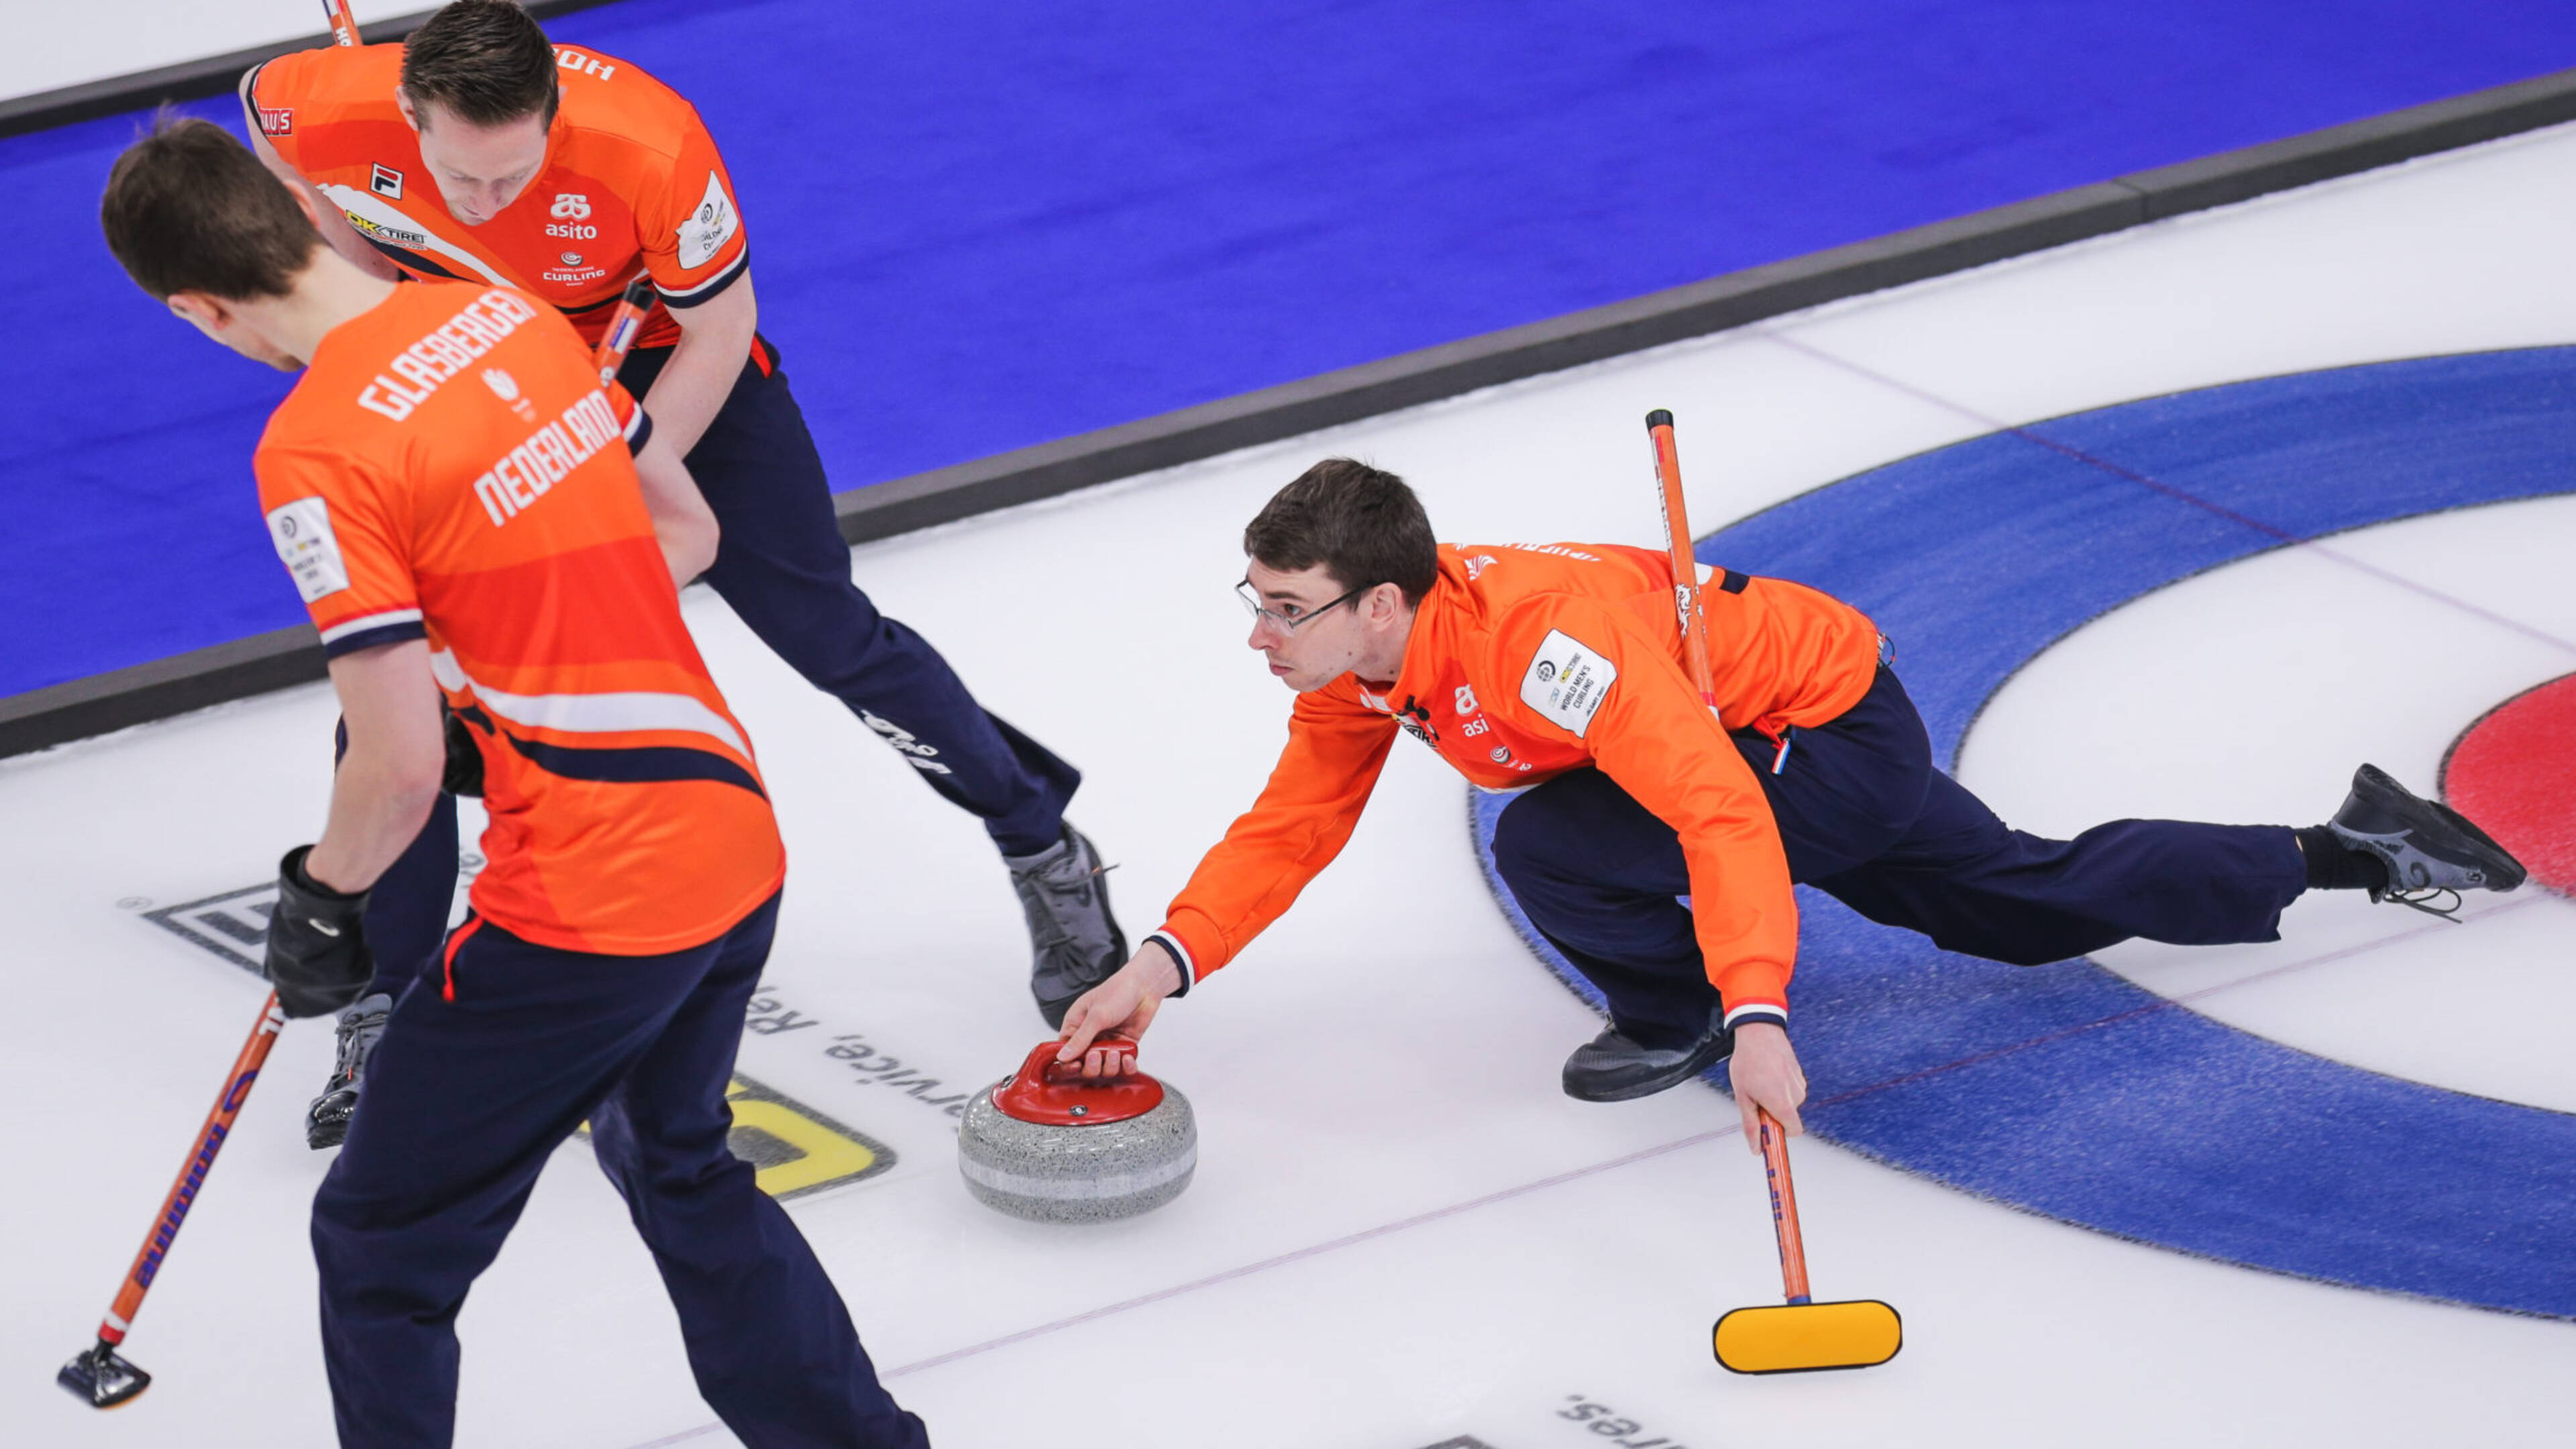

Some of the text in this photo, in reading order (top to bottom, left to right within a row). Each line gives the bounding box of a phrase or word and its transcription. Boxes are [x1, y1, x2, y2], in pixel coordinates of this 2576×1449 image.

[552, 48, 616, 81] HO
[545, 221, 598, 239] asito
[357, 289, 538, 422] GLASBERGEN
[473, 389, 622, 527] NEDERLAND
[1560, 665, 1591, 711] WORLD MEN'S
[1573, 678, 1595, 709] CURLING
[1462, 713, 1491, 737] asi
[1556, 1394, 1686, 1449] res.
